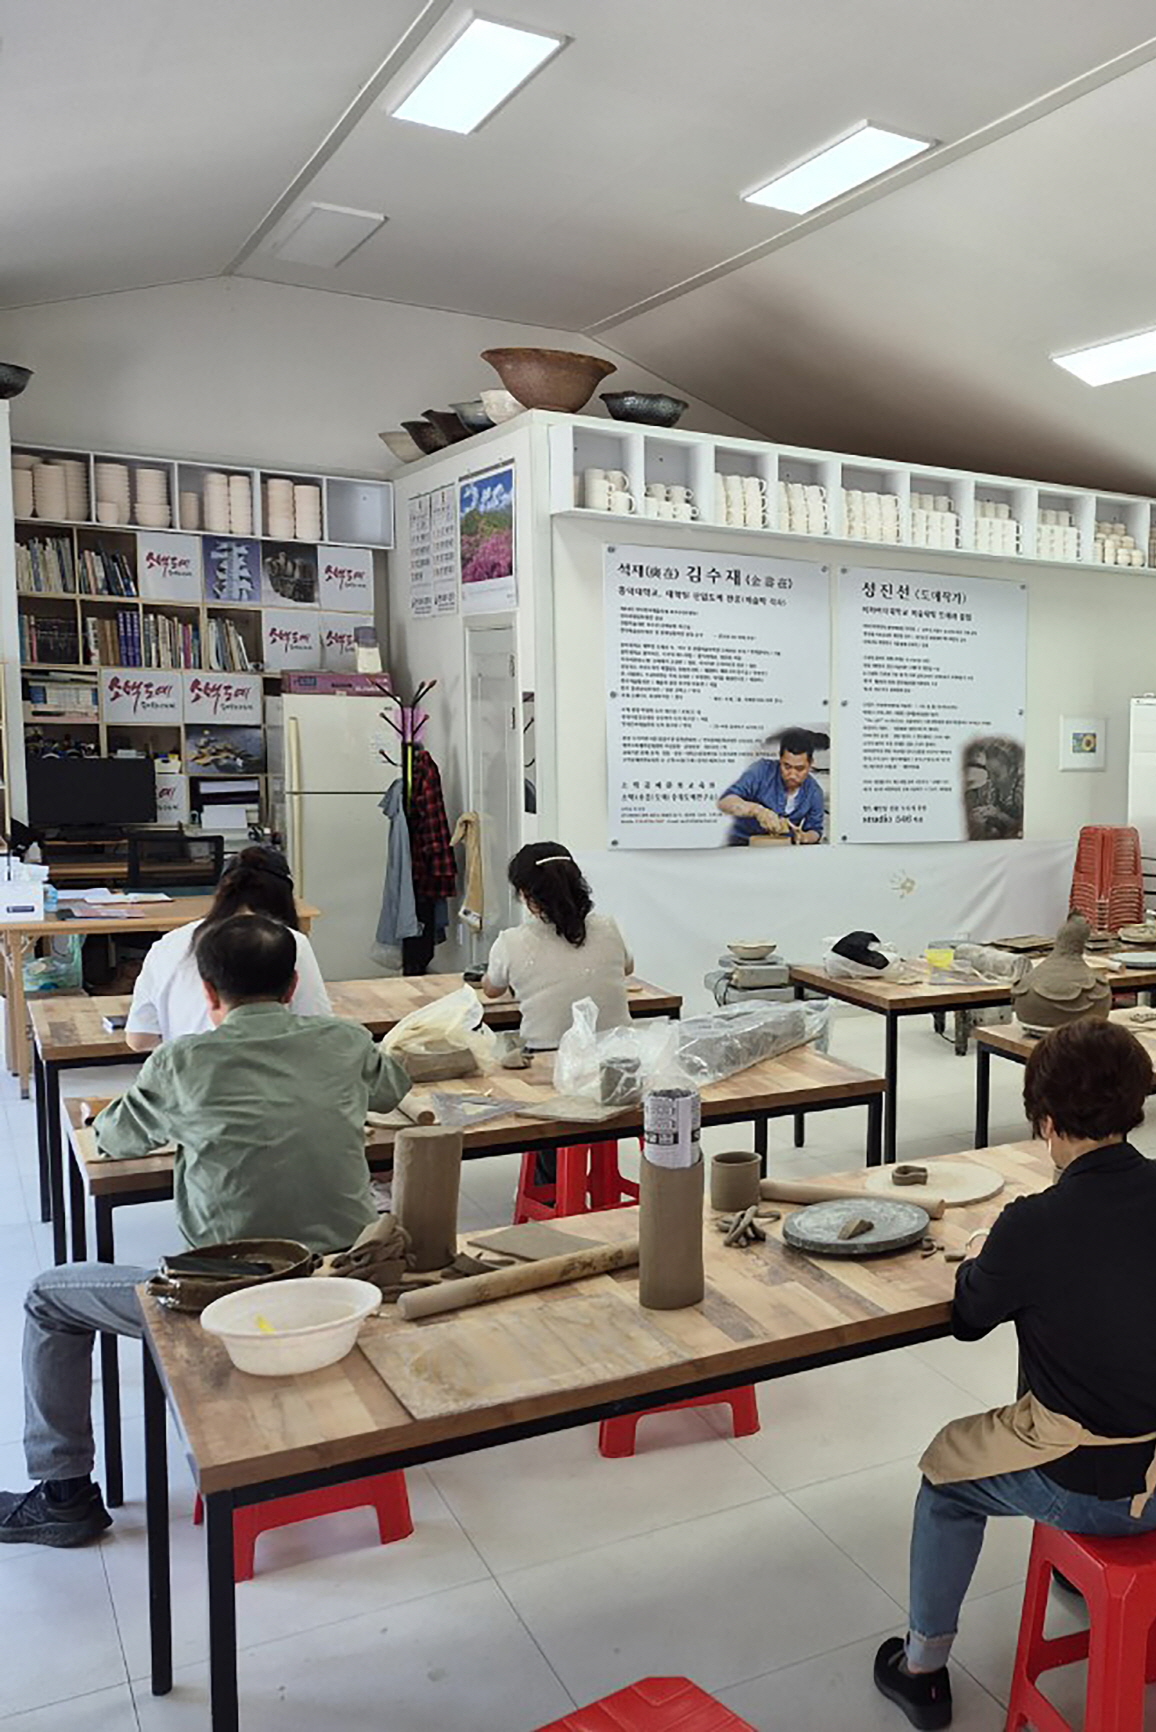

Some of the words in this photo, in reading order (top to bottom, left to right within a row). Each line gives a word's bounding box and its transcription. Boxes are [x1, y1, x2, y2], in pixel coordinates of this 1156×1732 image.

[686, 565, 741, 586] 김수재
[326, 630, 355, 654] 소백도
[108, 676, 173, 714] 소백도예
[190, 678, 251, 715] 소백도예
